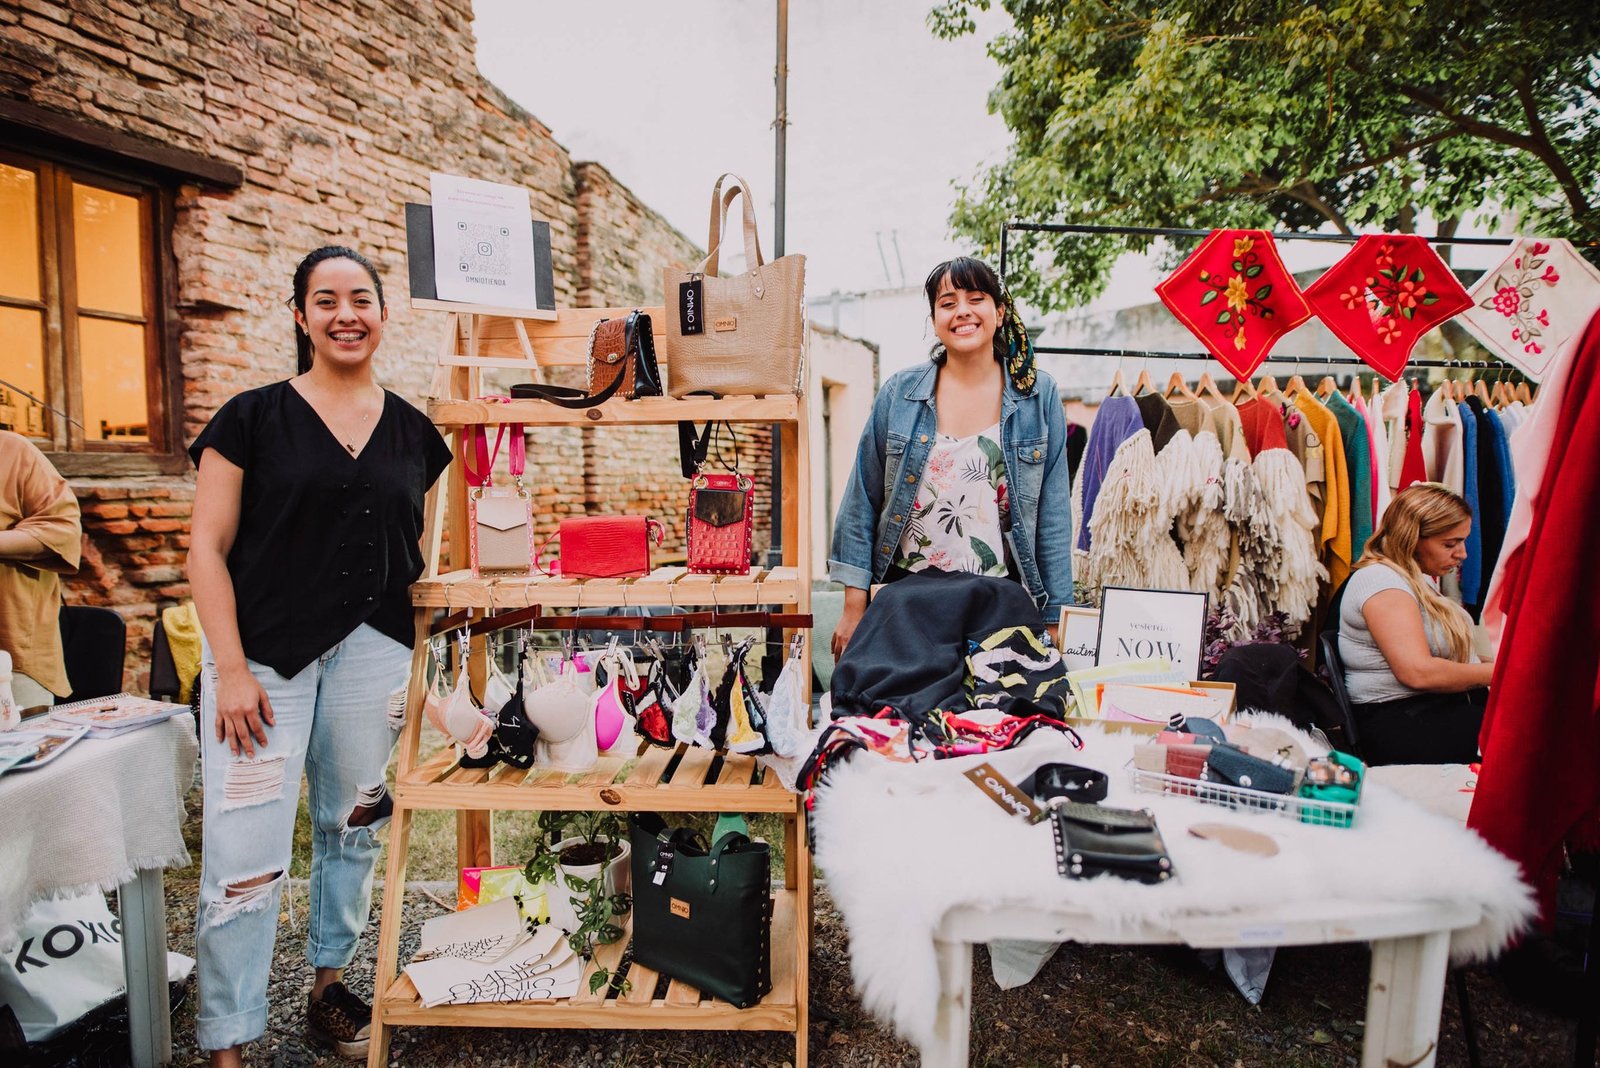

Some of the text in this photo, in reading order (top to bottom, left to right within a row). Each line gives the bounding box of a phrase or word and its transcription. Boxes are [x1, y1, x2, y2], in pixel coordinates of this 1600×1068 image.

[686, 289, 695, 323] OMNIO
[715, 320, 735, 328] OMNIO
[1116, 637, 1182, 664] NOW.
